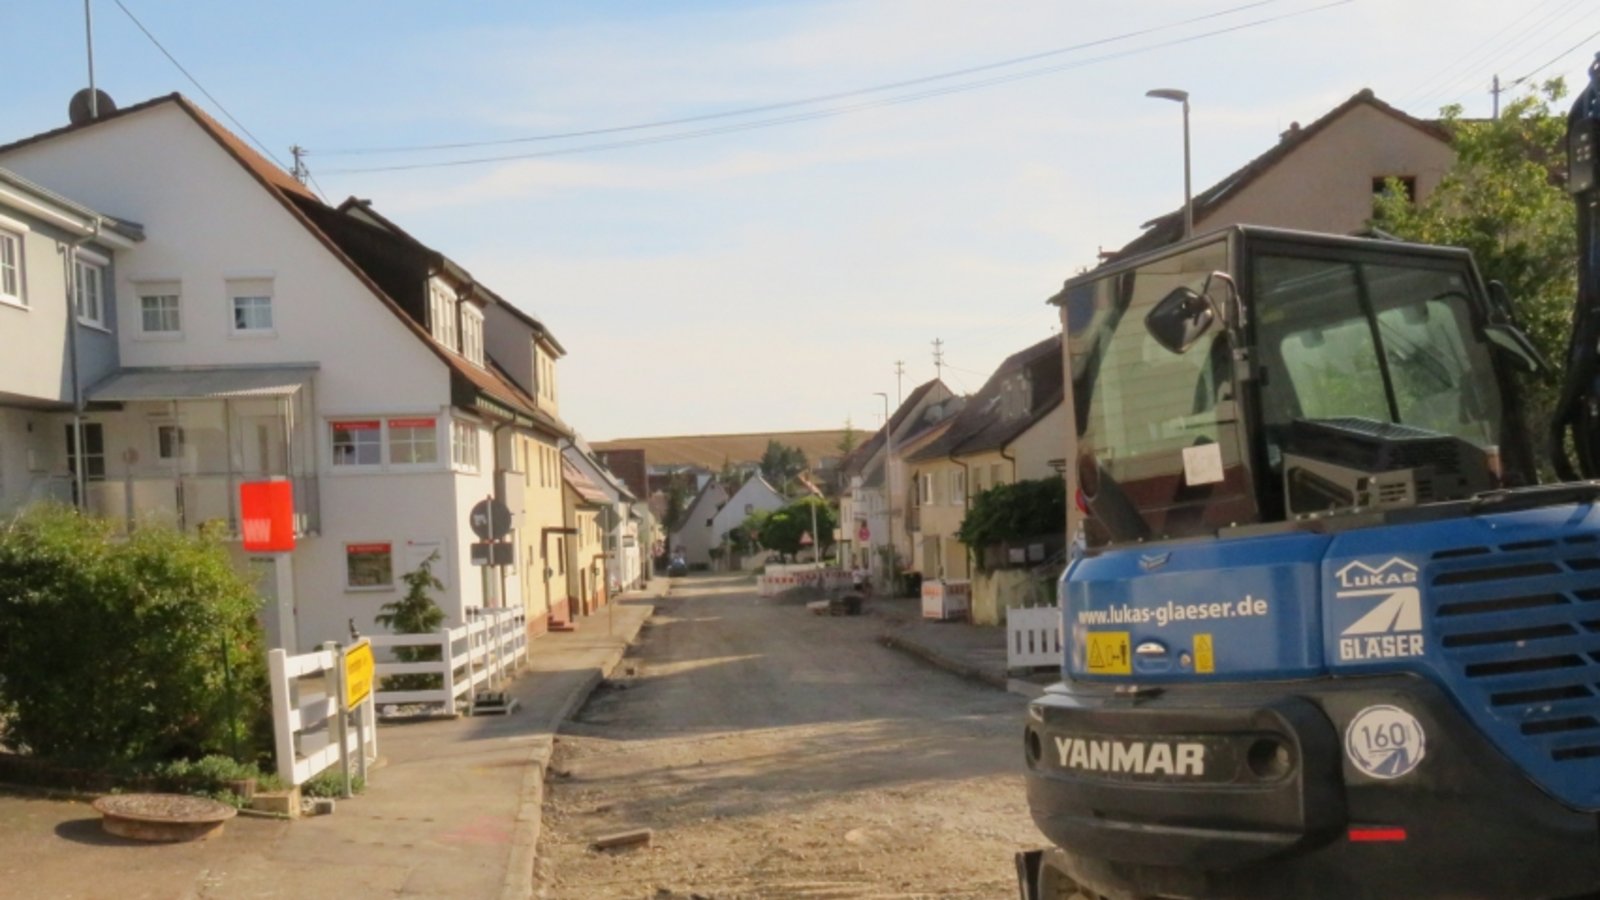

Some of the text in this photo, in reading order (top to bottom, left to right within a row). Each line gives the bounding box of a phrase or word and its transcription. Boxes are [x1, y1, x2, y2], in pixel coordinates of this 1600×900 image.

[1341, 568, 1417, 588] LUKAS
[1078, 595, 1268, 626] www.lukas-glaeser.de
[1340, 635, 1424, 660] GLÄSER
[1361, 722, 1406, 749] 160
[1054, 736, 1205, 775] YANMAR
